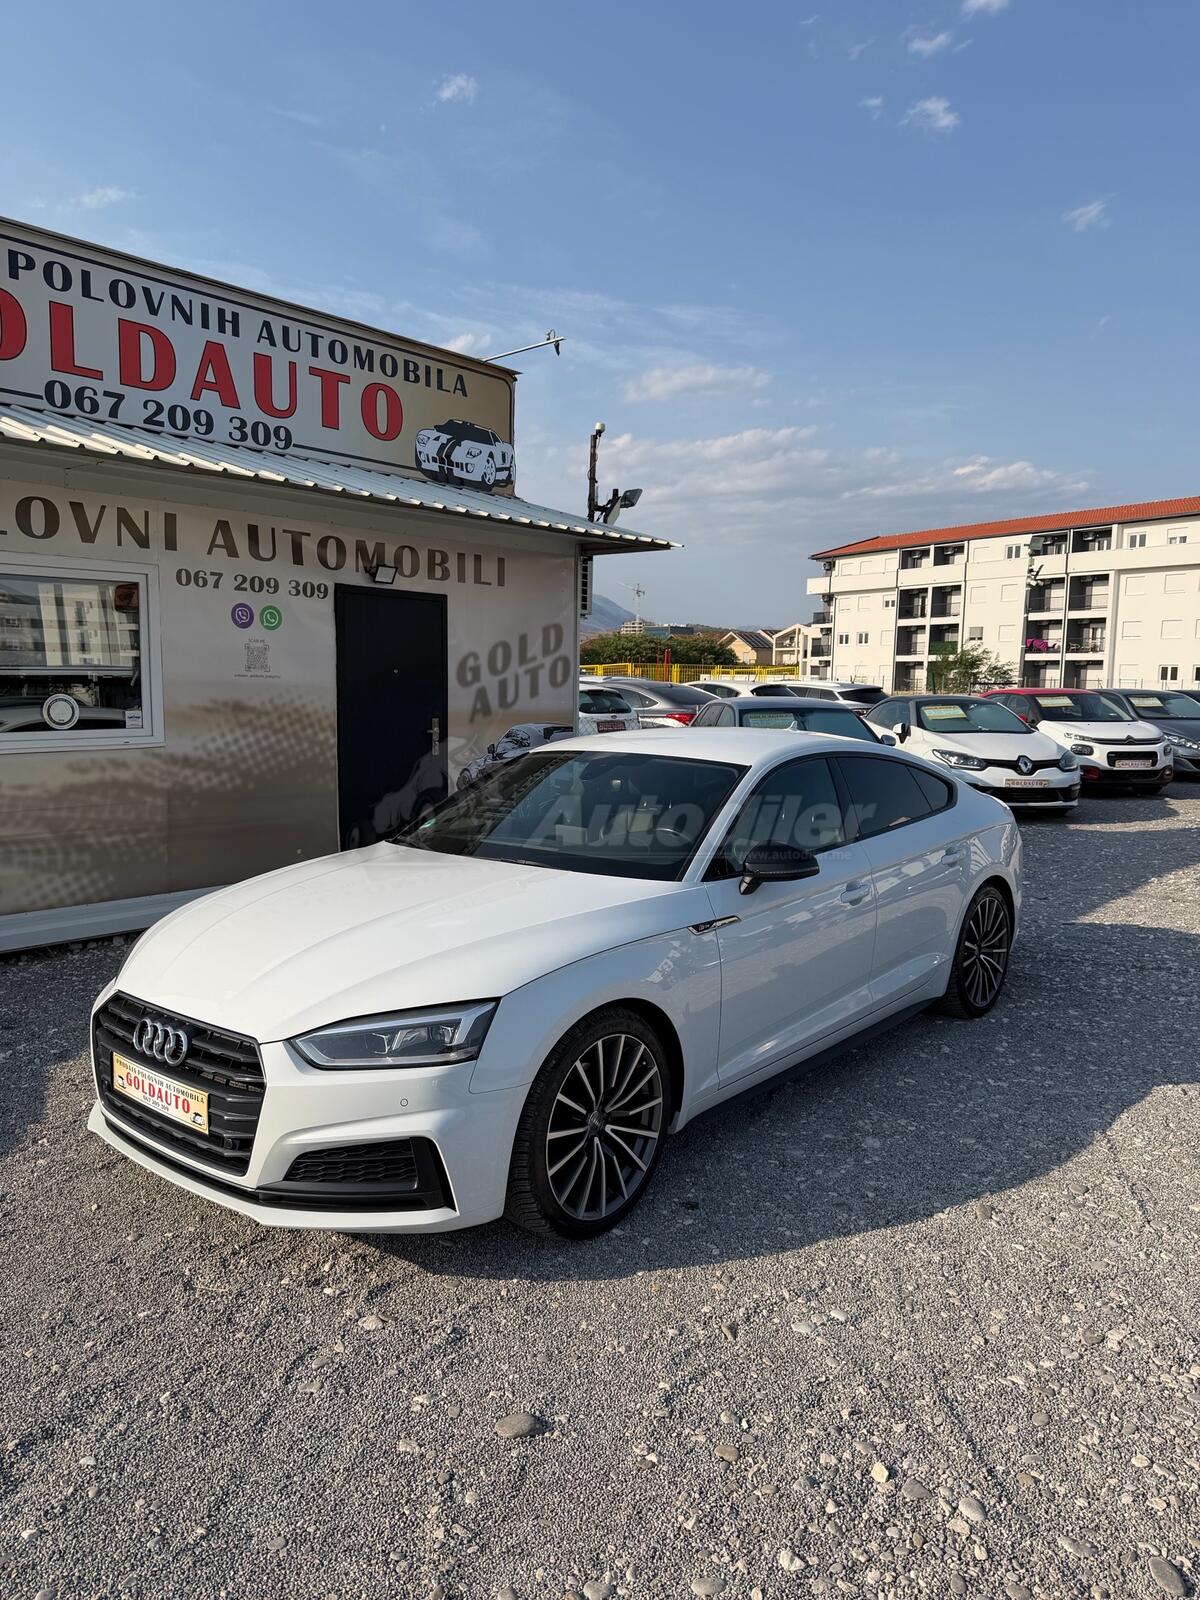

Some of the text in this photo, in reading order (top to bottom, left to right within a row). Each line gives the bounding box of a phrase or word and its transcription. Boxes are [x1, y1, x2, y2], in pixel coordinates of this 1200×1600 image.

[8, 249, 468, 397] POLOVNIH AUTOMOBILA
[44, 380, 293, 450] 067 209 309
[0, 496, 507, 587] OVNI AUTOMOBILI
[176, 567, 329, 600] 067 209 309
[456, 622, 565, 688] GOLD
[468, 655, 571, 723] AUTO
[125, 1072, 191, 1114] GOLDAUTO
[165, 1082, 205, 1104] AUTOMOBILA
